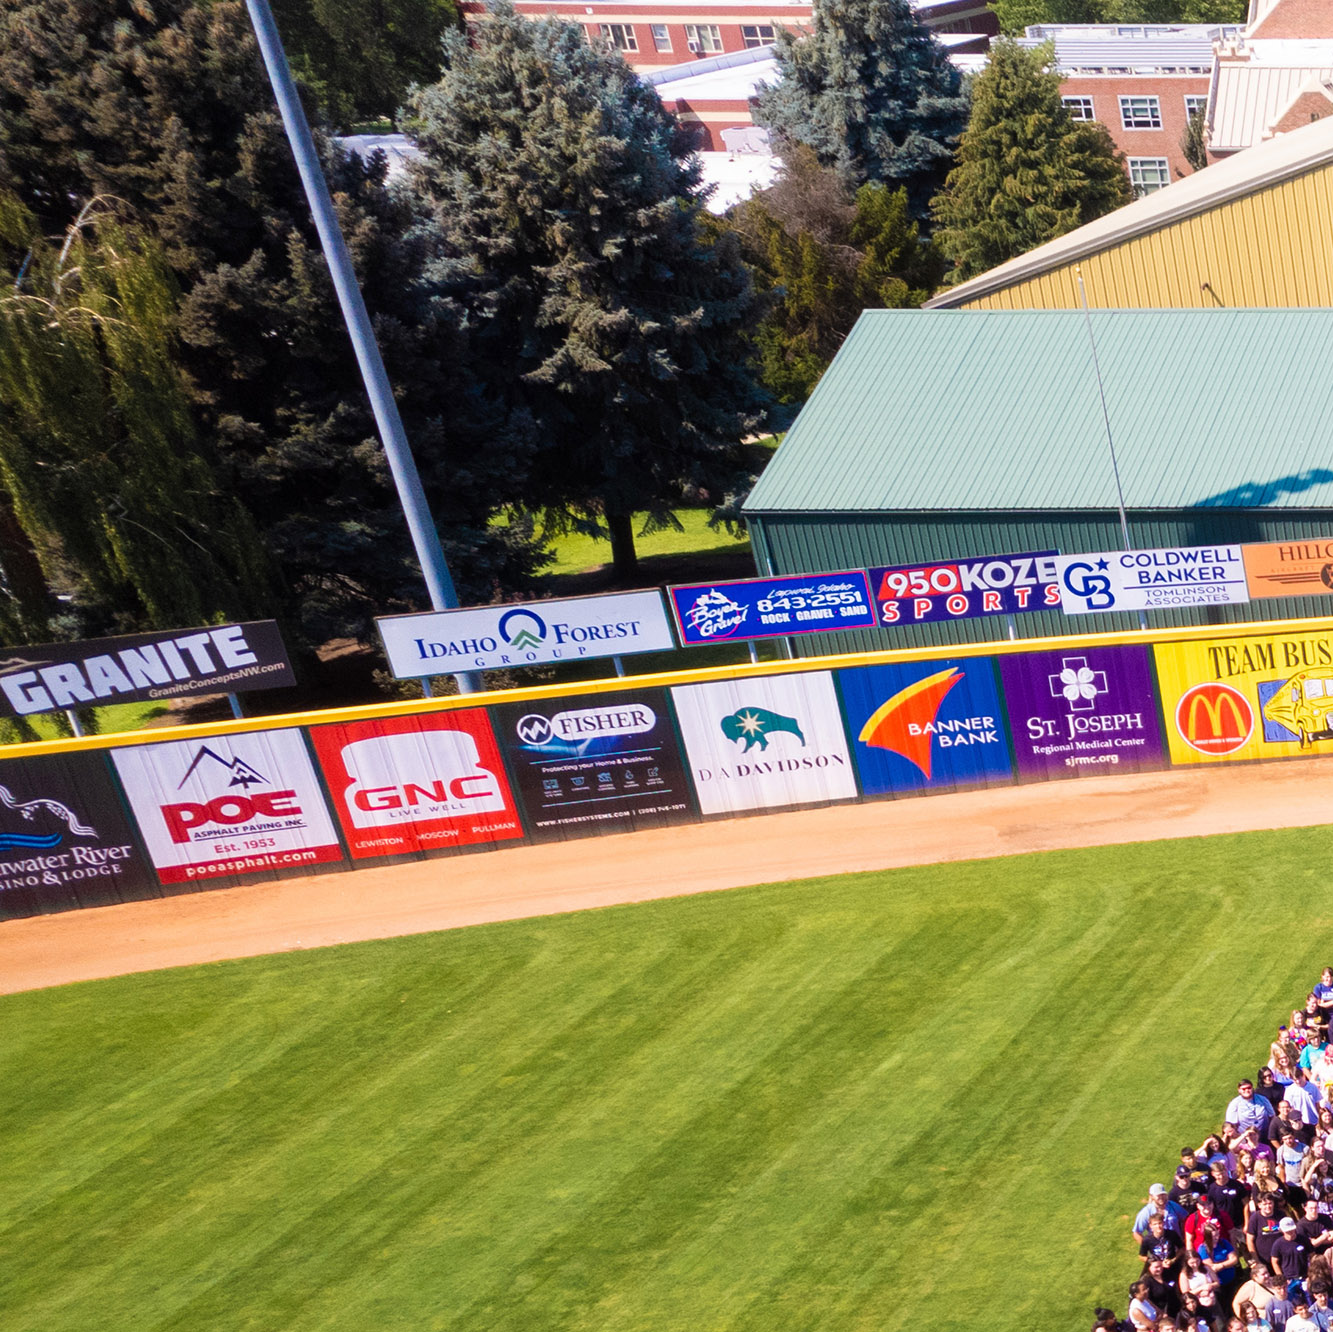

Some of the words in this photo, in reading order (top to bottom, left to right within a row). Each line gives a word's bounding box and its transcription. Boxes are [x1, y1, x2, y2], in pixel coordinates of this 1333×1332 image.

[1119, 548, 1240, 569] COLDWELL
[1138, 566, 1226, 584] BANKER
[882, 585, 1060, 622] SPORTS
[1144, 586, 1227, 597] TOMLINSON
[1144, 593, 1231, 607] ASSOCIATES
[700, 610, 748, 637] Gravel
[760, 611, 790, 625] ROCK
[795, 608, 835, 622] GRAVEL
[840, 605, 868, 618] SAND
[415, 636, 497, 660] IDAHO
[551, 620, 641, 651] FOREST
[474, 647, 588, 668] GROUP
[1208, 642, 1277, 680] TEAM
[1282, 637, 1333, 668] BUS
[0, 625, 258, 716] GRANITE
[149, 661, 285, 703] GraniteConceptsNW.com
[559, 710, 650, 735] FISHER
[908, 715, 996, 742] BANNER
[939, 730, 999, 754] BANK
[1033, 741, 1073, 755] Regional
[1075, 739, 1111, 752] Medical
[1113, 737, 1146, 749] Center
[737, 752, 845, 778] DAVIDSON
[1064, 753, 1119, 768] sjrmc.org
[355, 775, 494, 813] GNC
[160, 790, 303, 845] POE
[389, 806, 422, 818] LIVE
[429, 802, 467, 815] WELL
[193, 824, 240, 841] ASPHALT
[242, 821, 282, 836] PAVING
[355, 836, 404, 850] LEWISTON
[416, 829, 460, 842] MOSCOW
[472, 821, 516, 834] PULLMAN
[70, 845, 132, 870] River
[214, 841, 241, 855] Est.
[243, 837, 276, 853] 1953
[42, 870, 62, 886] &
[62, 863, 122, 886] LODGE
[186, 848, 317, 878] poeasphalt.com
